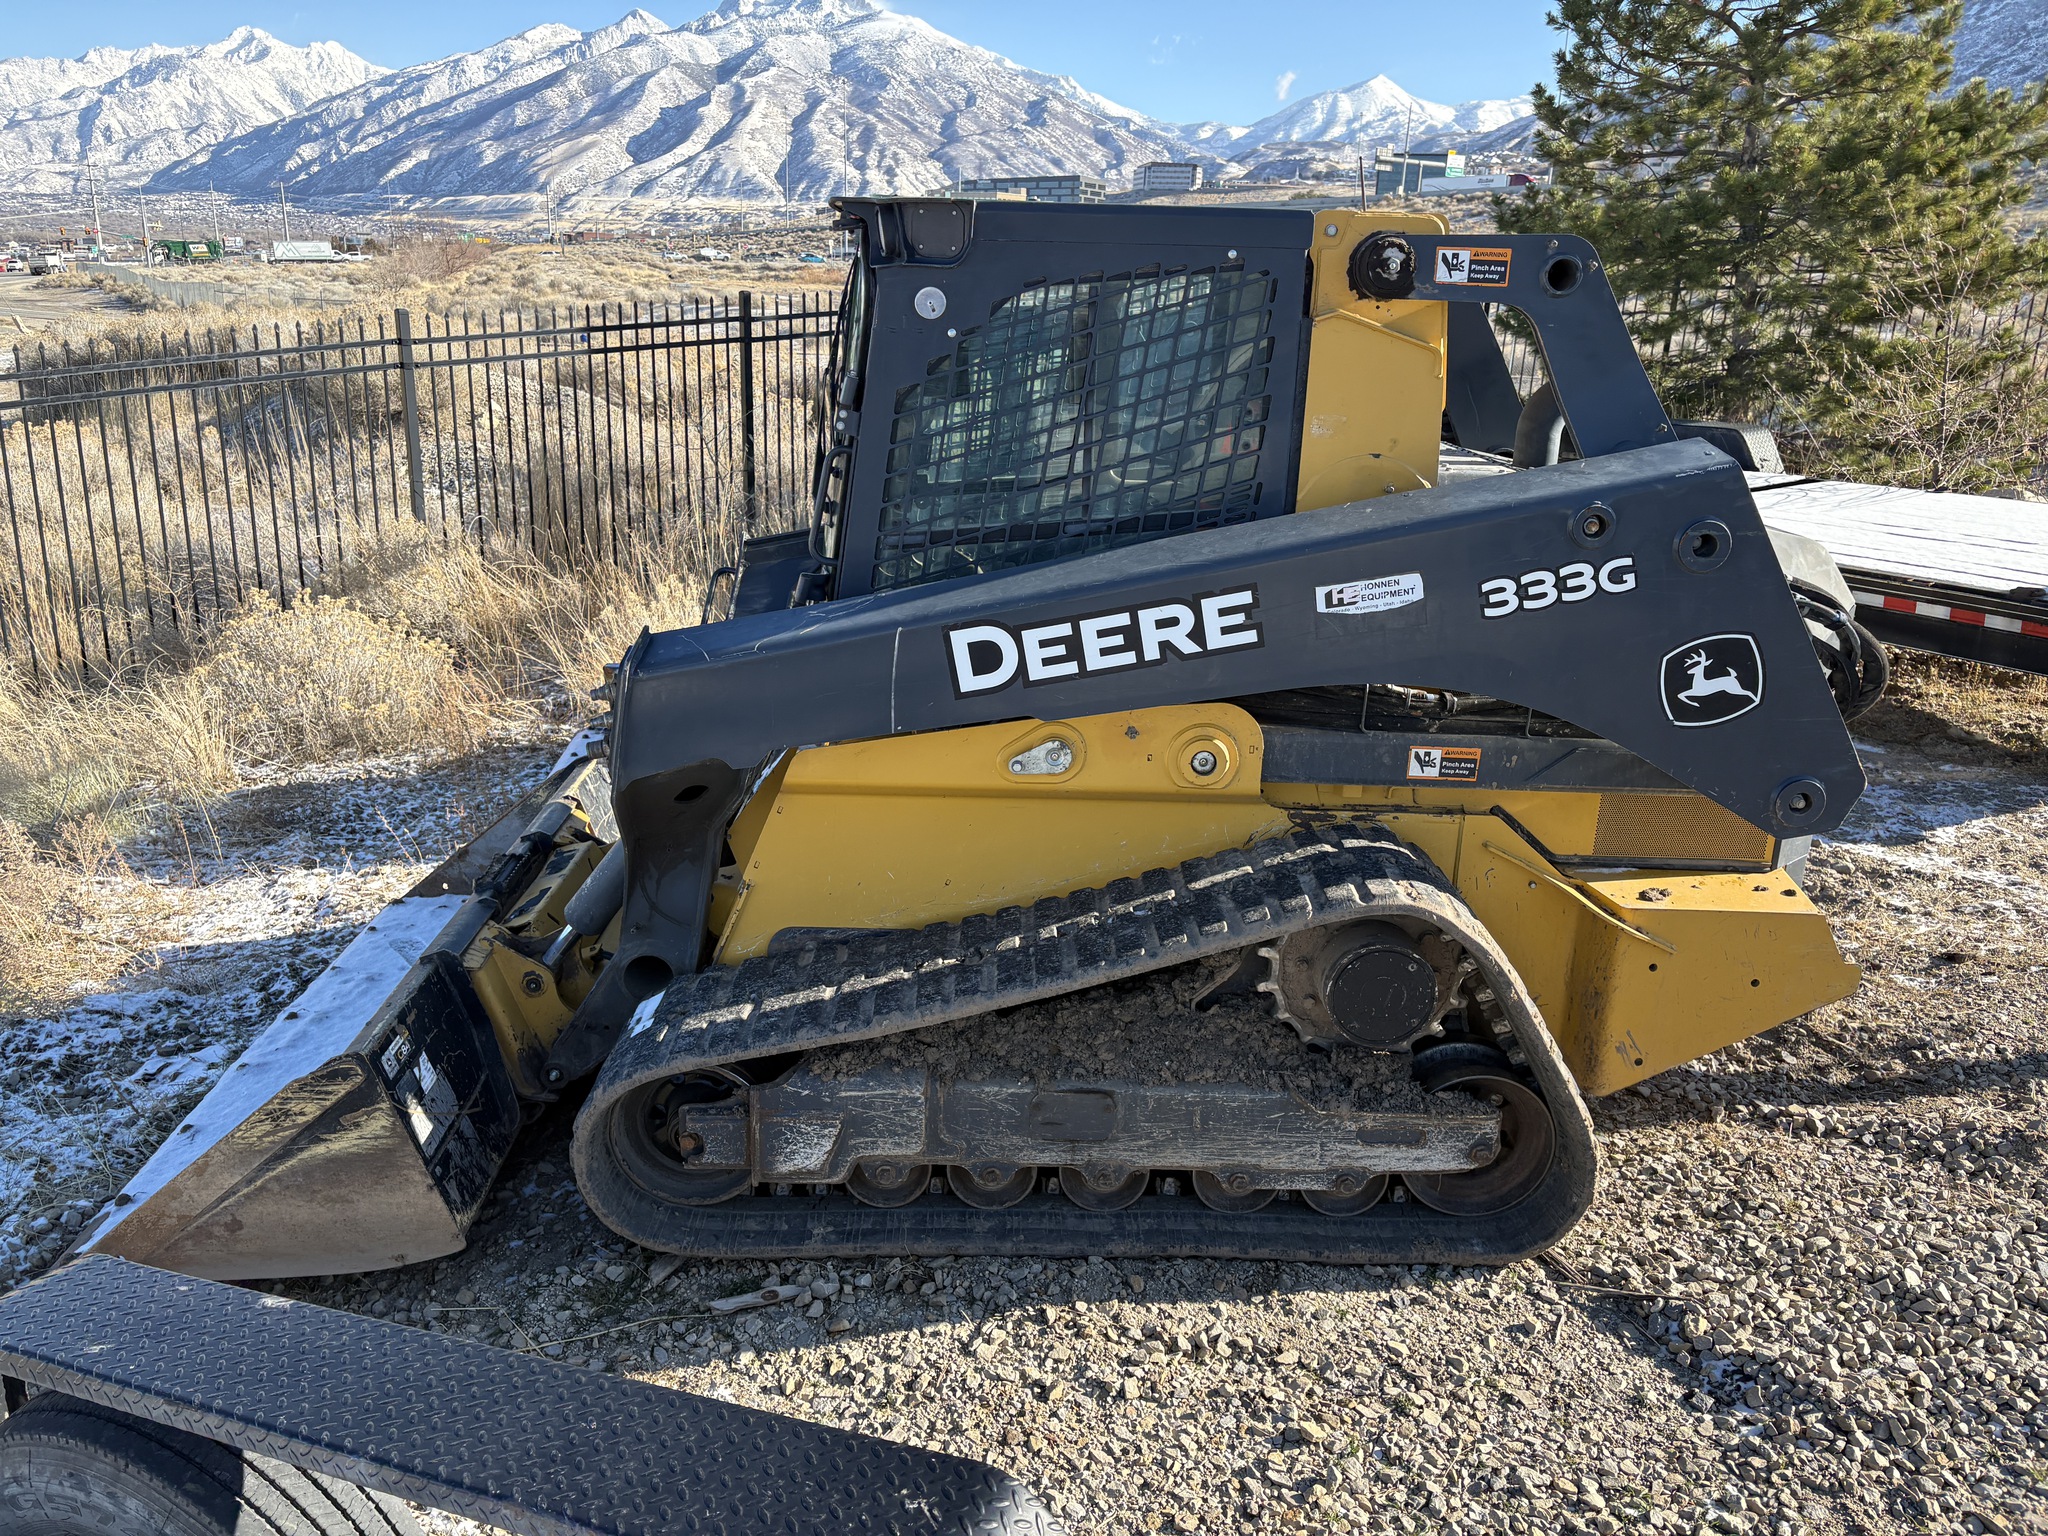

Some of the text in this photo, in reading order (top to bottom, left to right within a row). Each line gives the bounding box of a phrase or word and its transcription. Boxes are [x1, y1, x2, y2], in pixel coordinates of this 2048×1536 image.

[1360, 579, 1400, 592] HONNEN
[1481, 557, 1636, 617] 333G
[1361, 587, 1416, 602] EQUIPMENT
[1354, 603, 1379, 612] Wyoming
[949, 590, 1258, 694] DEERE
